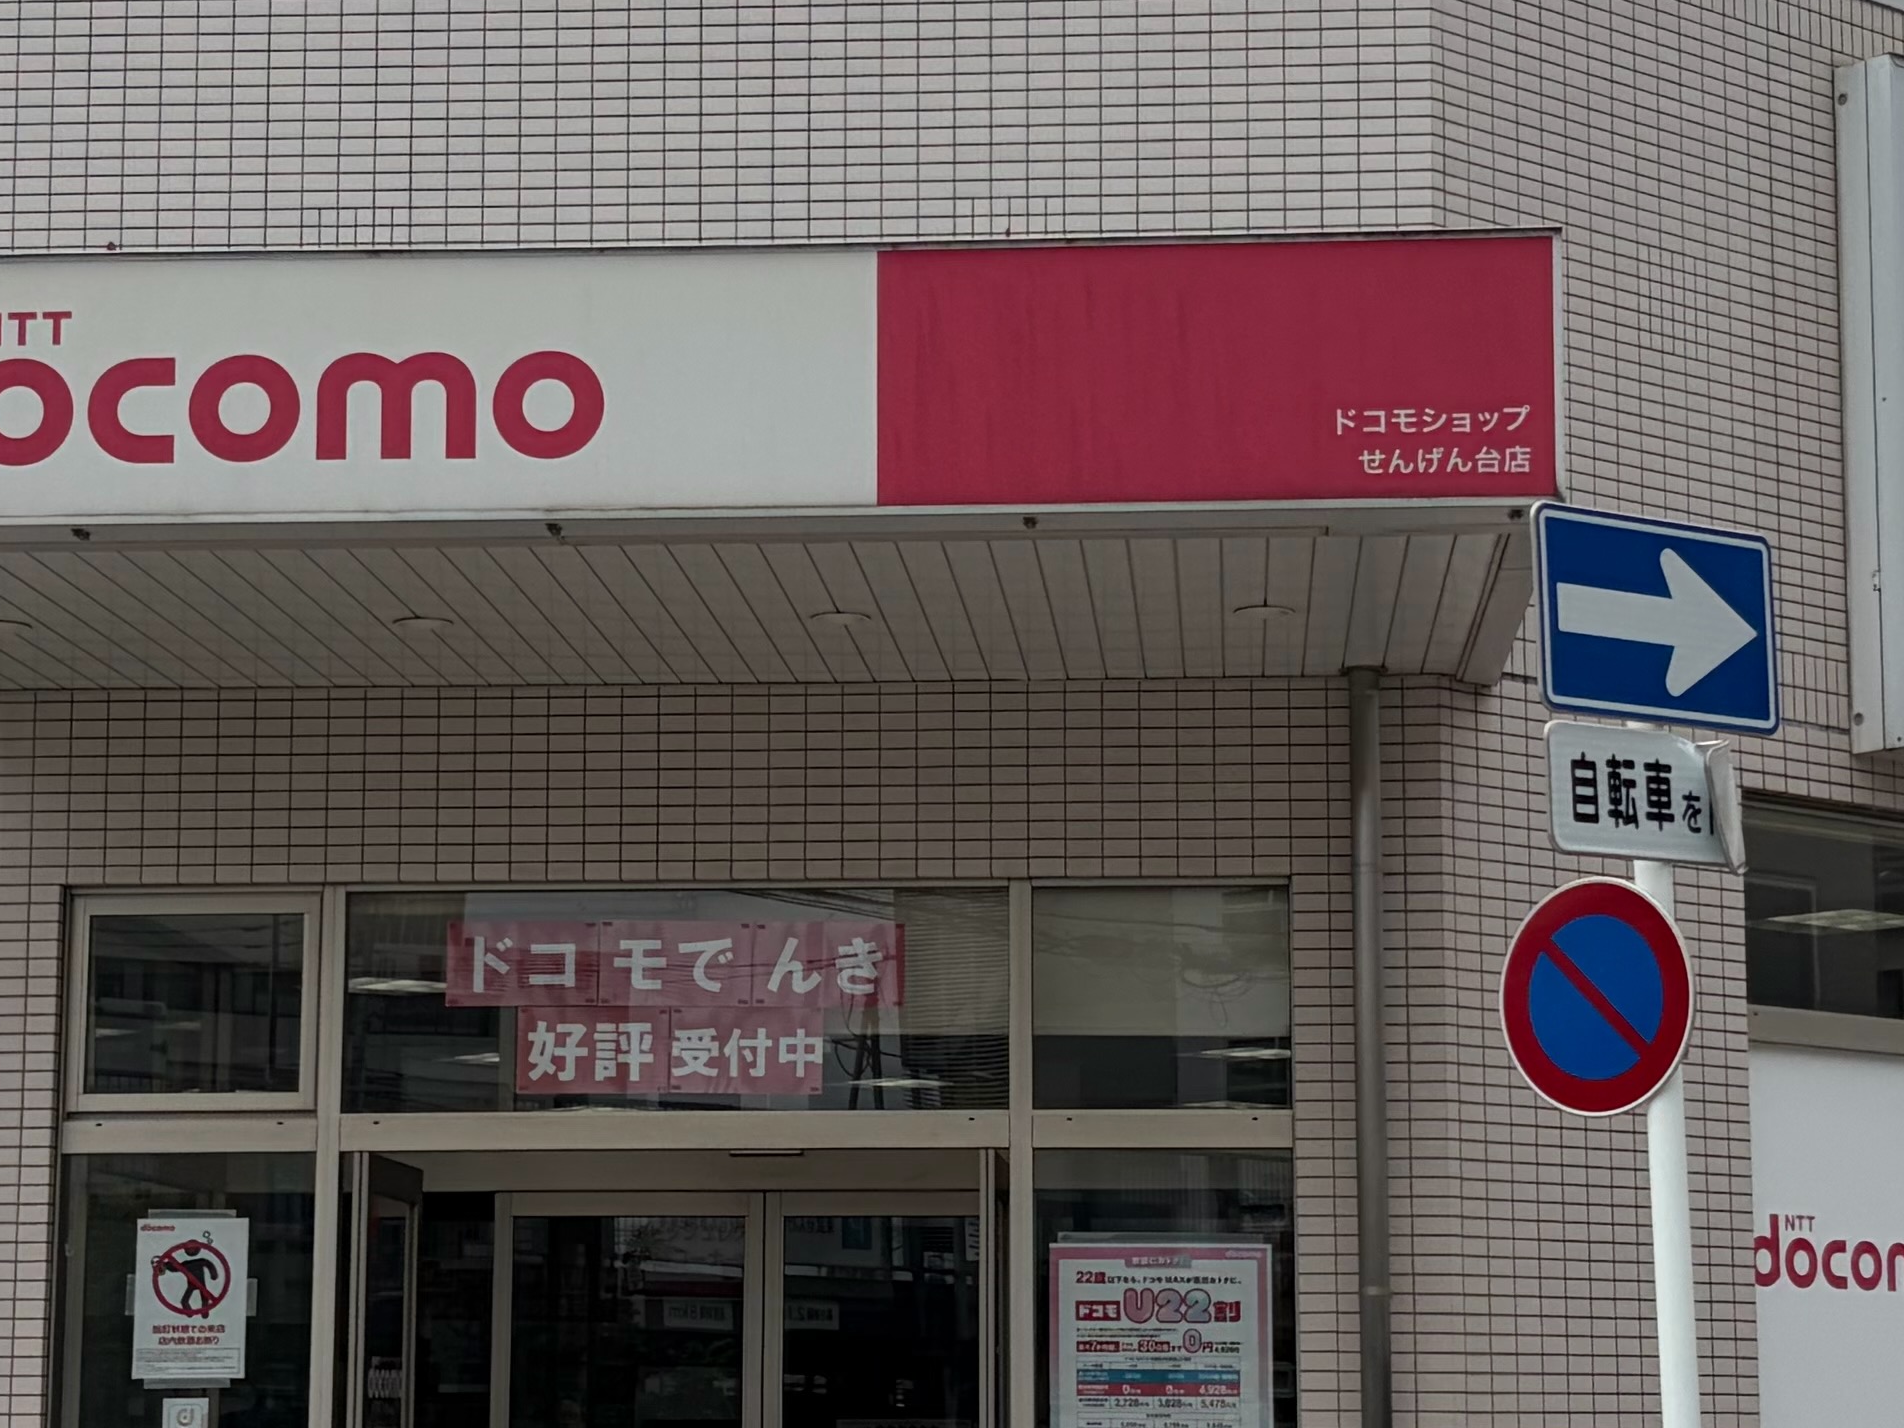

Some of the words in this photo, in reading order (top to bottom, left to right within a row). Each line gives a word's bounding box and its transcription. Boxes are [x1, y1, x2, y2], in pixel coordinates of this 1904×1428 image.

[1334, 405, 1531, 435] ドコモショップ
[1358, 445, 1532, 475] せんげん台店
[1571, 752, 1716, 836] 自転車を
[471, 935, 884, 995] ドコモでんき
[526, 1021, 824, 1083] 好評受付中
[1784, 1214, 1816, 1233] NTT
